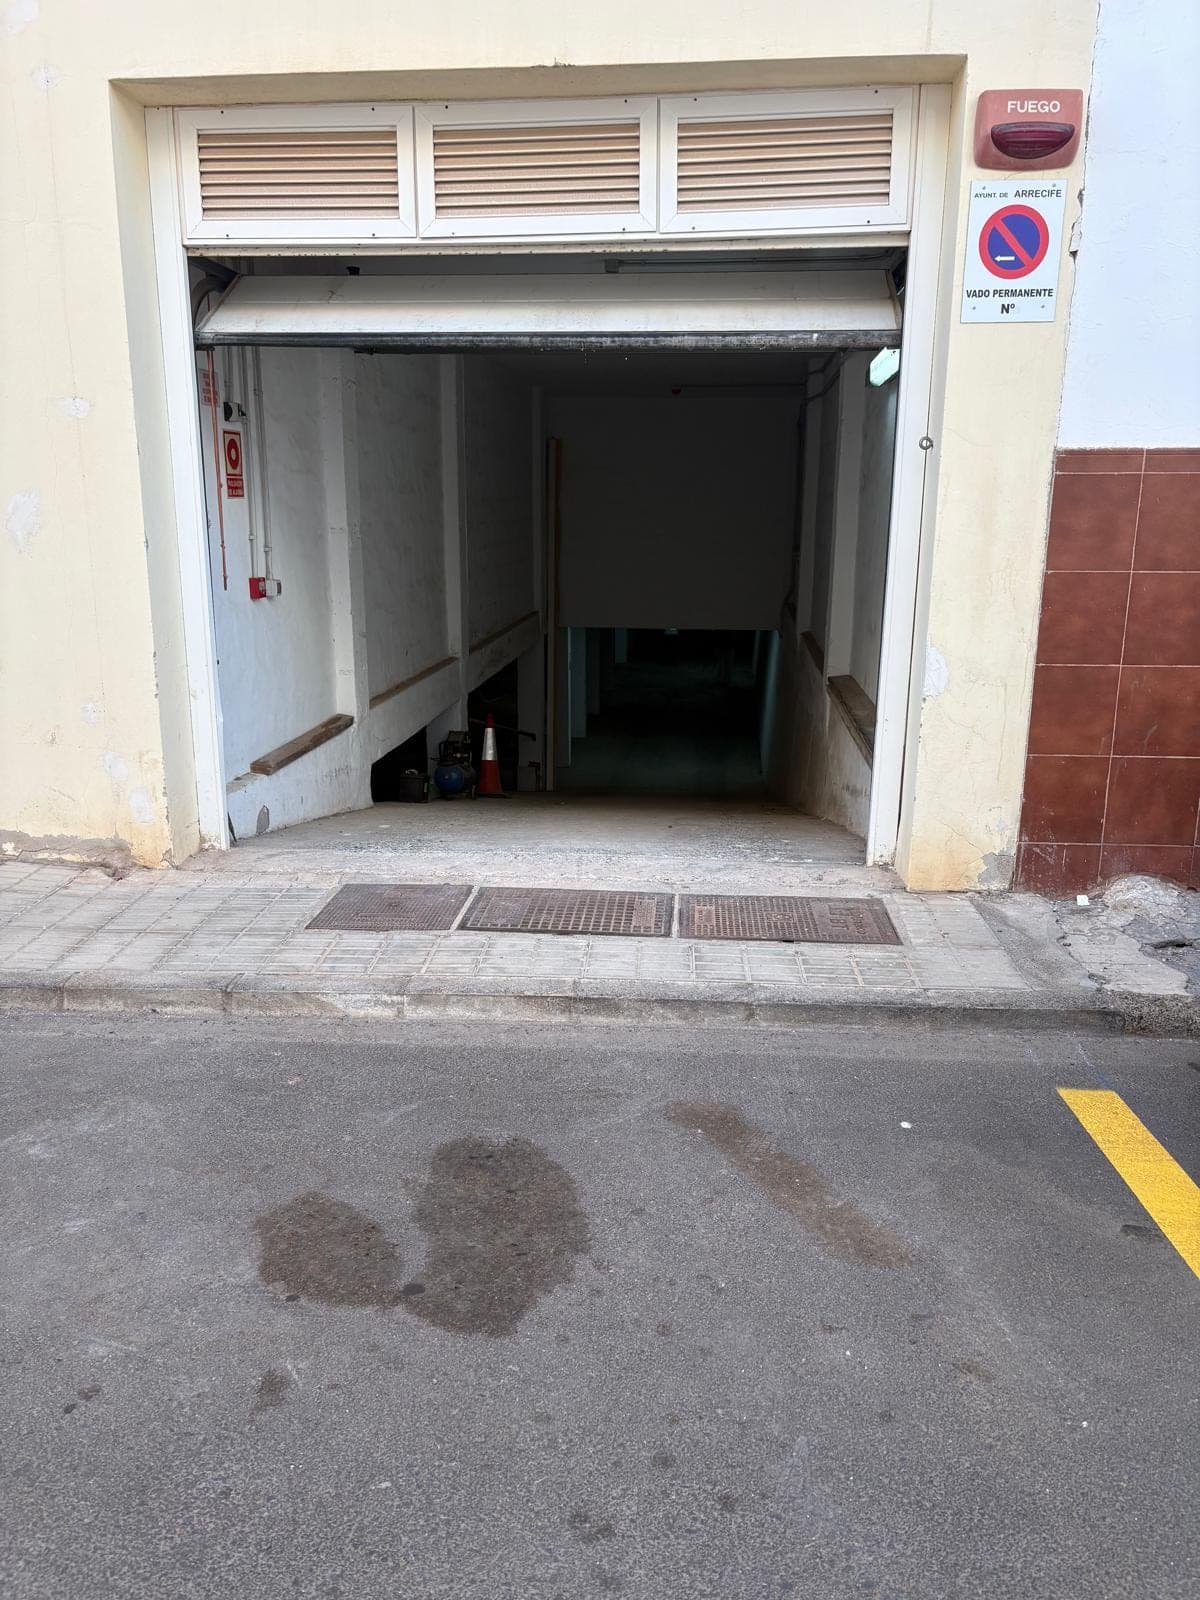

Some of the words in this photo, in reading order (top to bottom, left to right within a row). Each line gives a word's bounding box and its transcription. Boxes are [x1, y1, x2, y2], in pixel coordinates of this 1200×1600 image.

[1007, 100, 1061, 113] FUEGO
[1014, 189, 1062, 198] ARRECIFE
[966, 289, 990, 298] VADO
[992, 288, 1054, 298] PERMANENTE
[1000, 303, 1015, 314] Nº
